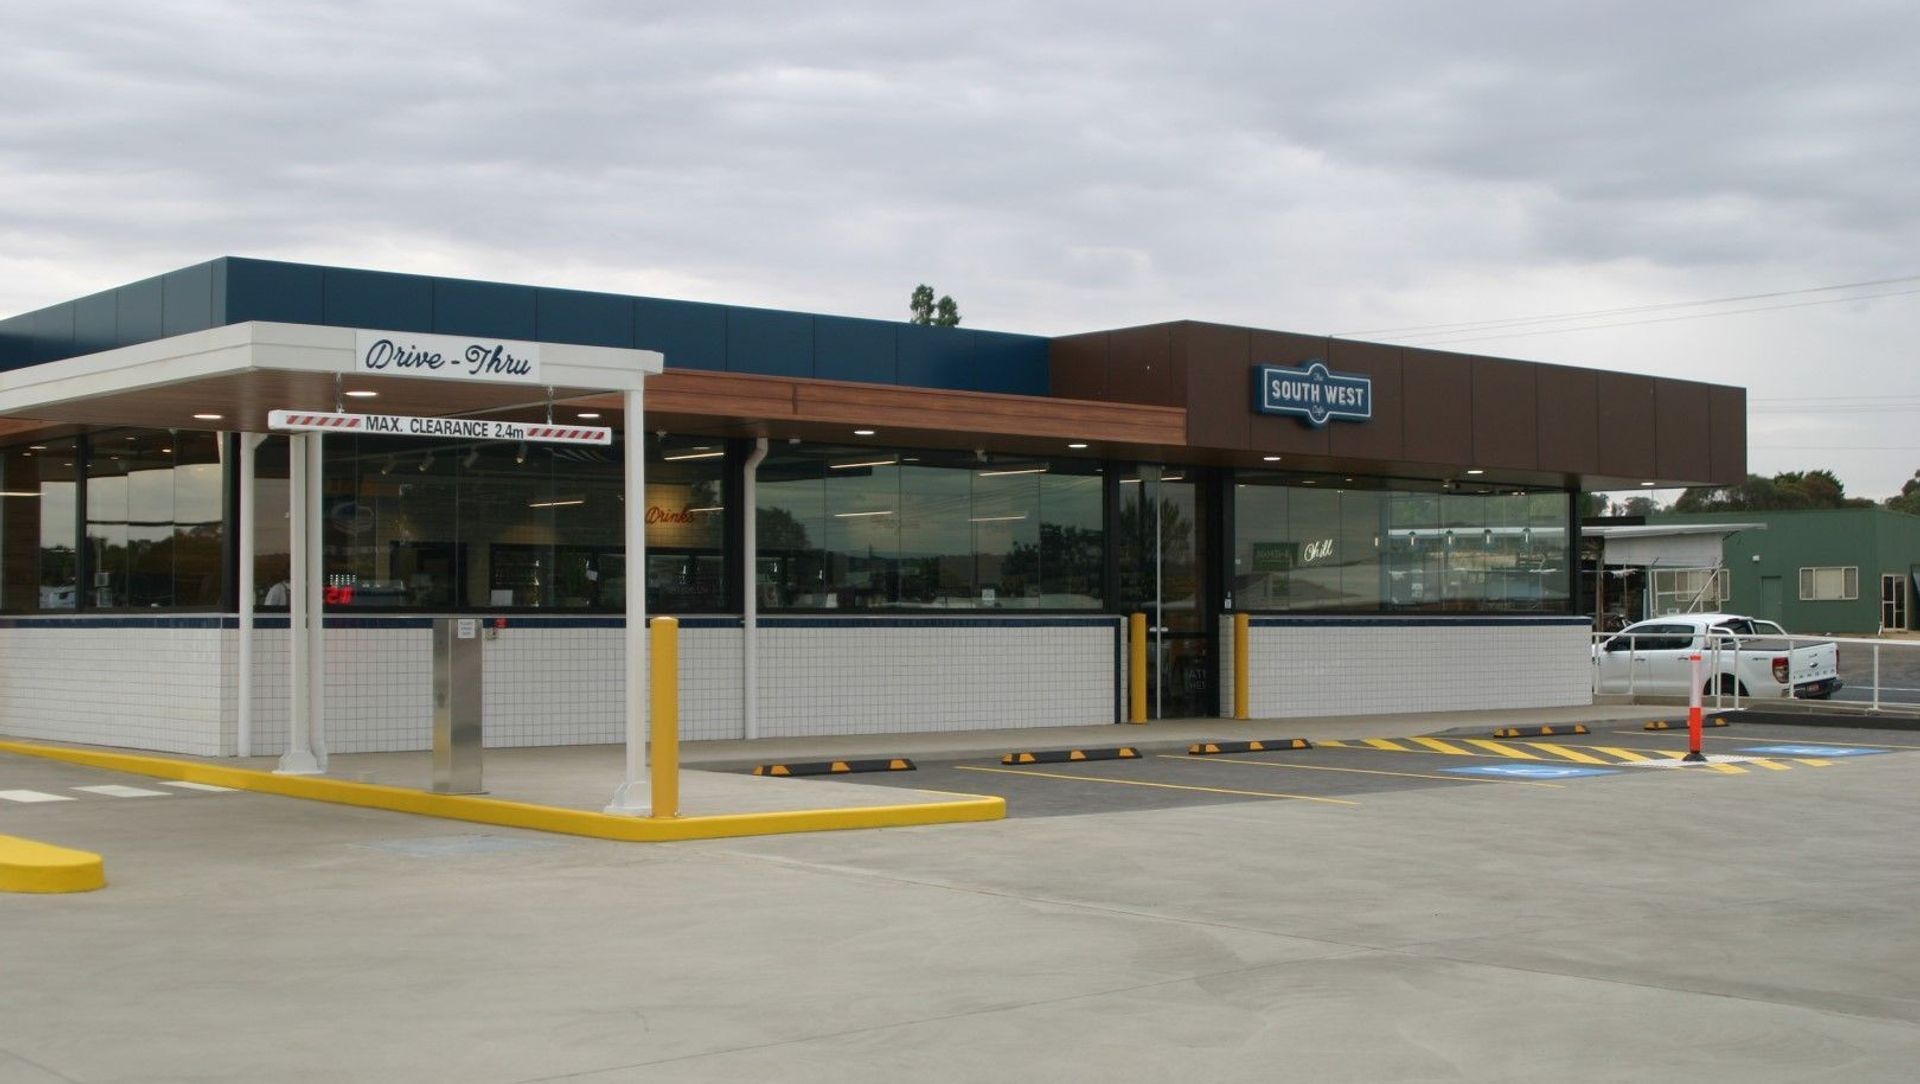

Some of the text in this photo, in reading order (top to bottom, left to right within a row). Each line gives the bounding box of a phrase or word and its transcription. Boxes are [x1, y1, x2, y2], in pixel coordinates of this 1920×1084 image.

[366, 339, 445, 369] Drive
[465, 345, 531, 375] Thru
[1271, 379, 1364, 407] SOUTH WEST
[365, 416, 525, 439] MAX. CLEARANCE 2.4m
[645, 504, 695, 525] Drinks
[1303, 539, 1333, 562] Chill
